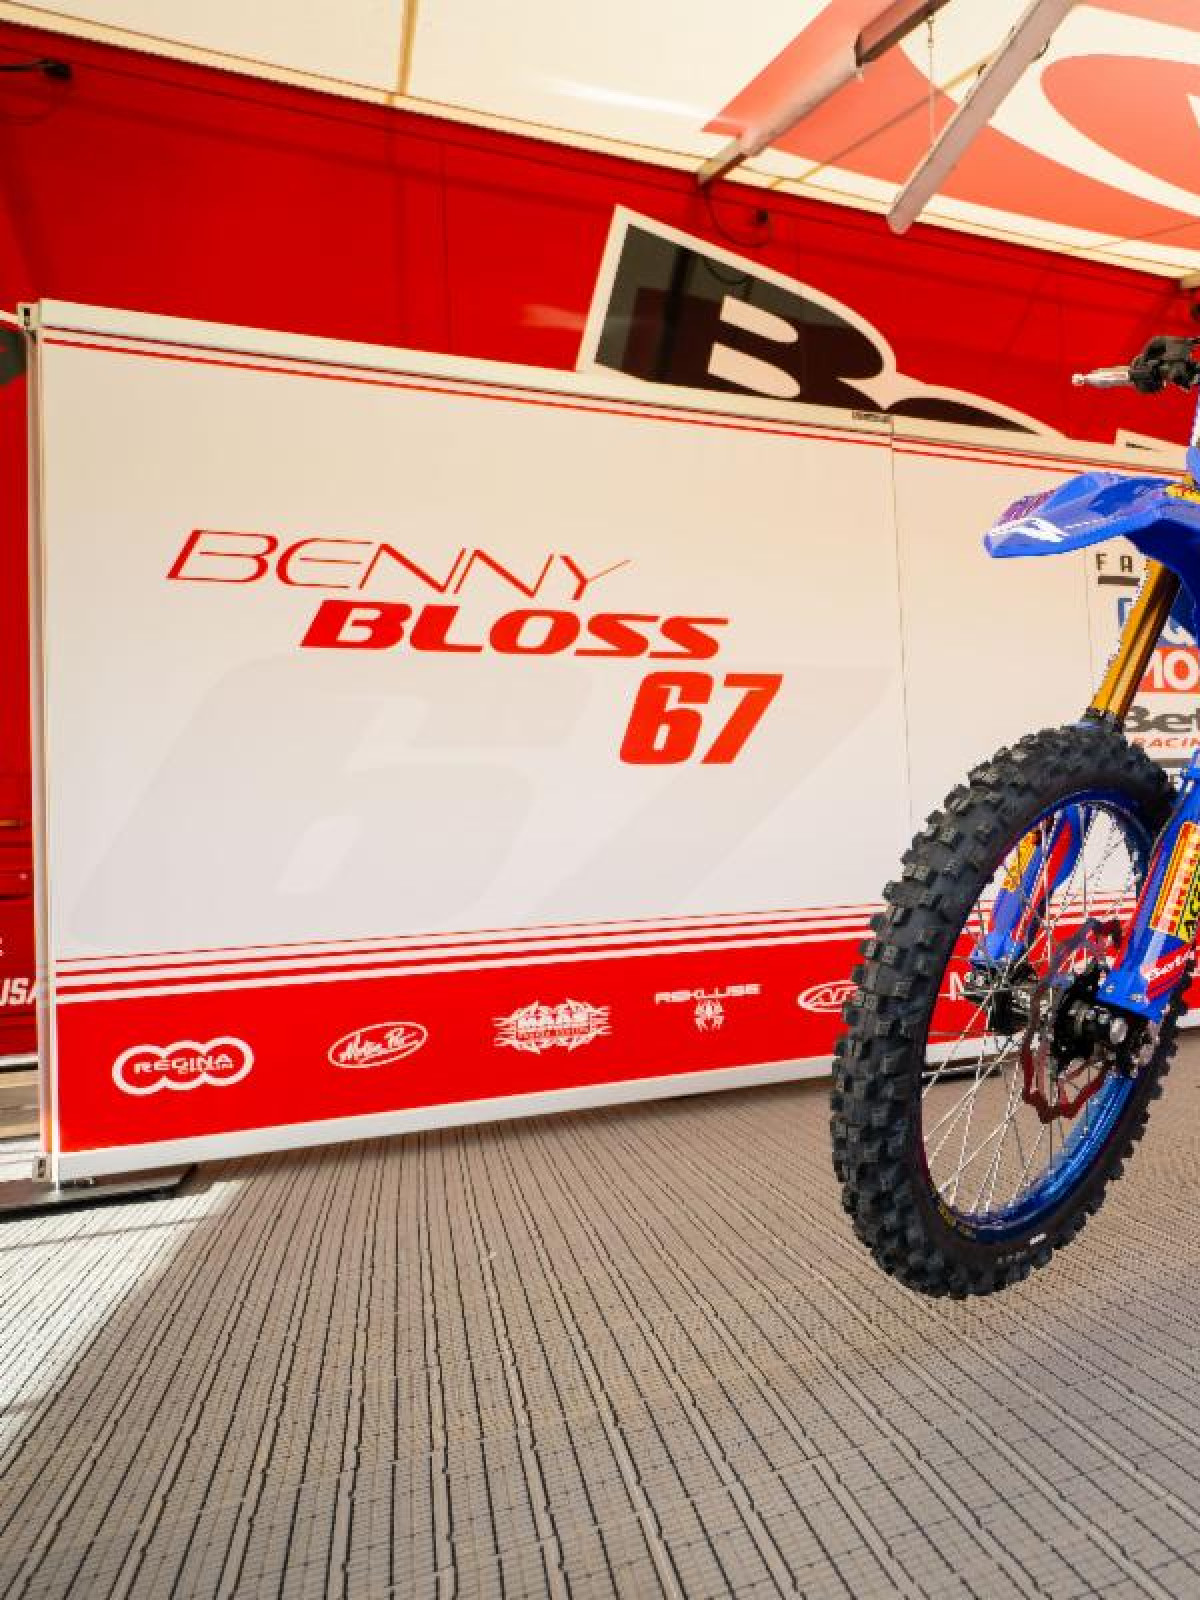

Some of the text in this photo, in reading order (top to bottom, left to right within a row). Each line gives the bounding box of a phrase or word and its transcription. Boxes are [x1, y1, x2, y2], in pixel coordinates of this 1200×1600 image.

[166, 528, 633, 601] BENNY
[299, 599, 730, 661] BLOSS
[618, 671, 784, 765] 67
[133, 1052, 235, 1075] REGINA
